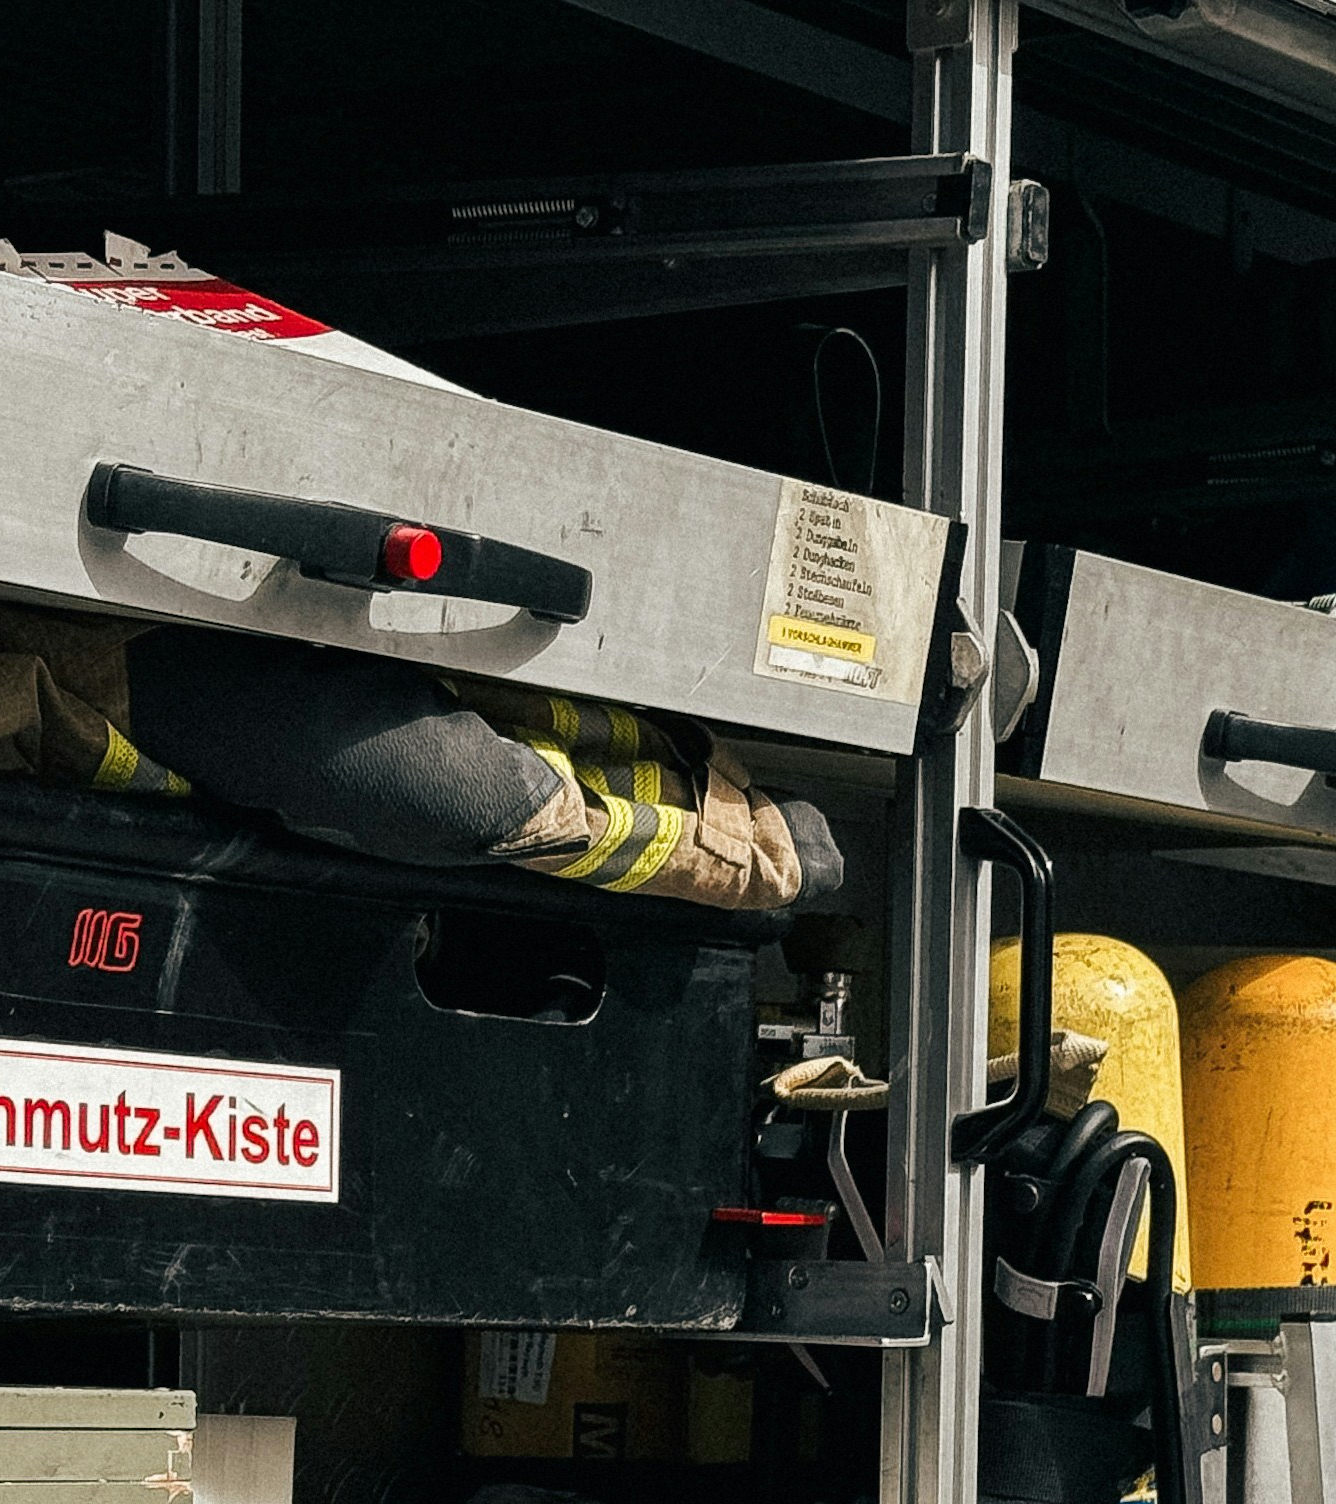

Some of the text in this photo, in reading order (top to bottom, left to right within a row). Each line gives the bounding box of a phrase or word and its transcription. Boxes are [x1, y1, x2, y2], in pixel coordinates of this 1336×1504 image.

[798, 507, 805, 520] 2
[795, 525, 802, 540] 2
[792, 546, 799, 559] 2
[789, 563, 796, 577] 2
[787, 582, 793, 596] 2
[784, 601, 791, 615] 2
